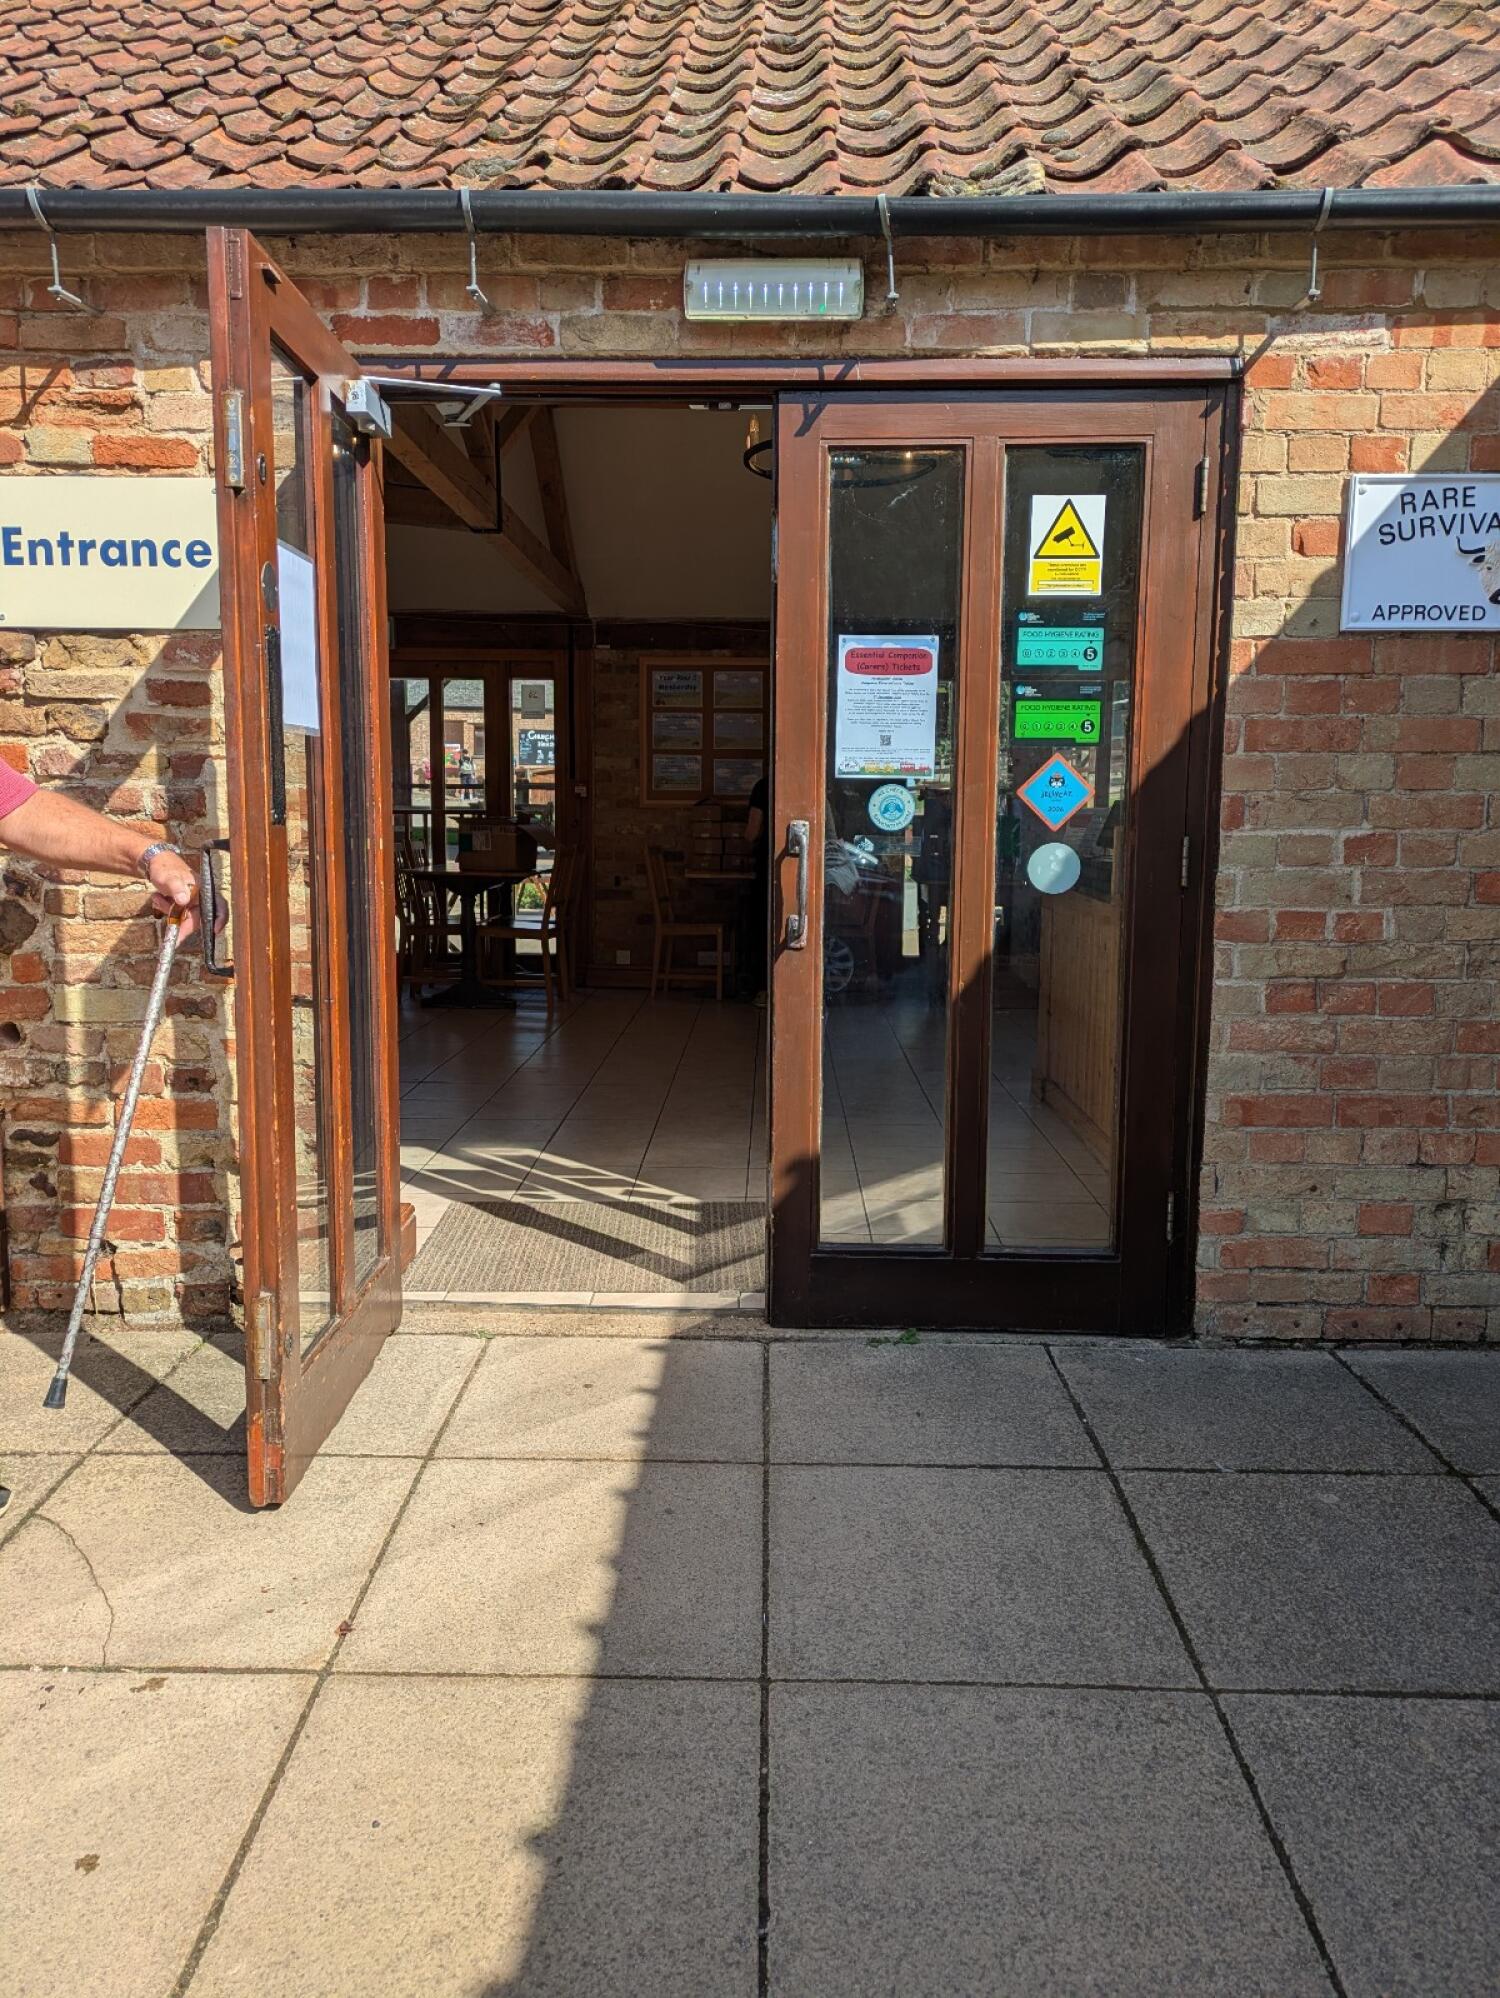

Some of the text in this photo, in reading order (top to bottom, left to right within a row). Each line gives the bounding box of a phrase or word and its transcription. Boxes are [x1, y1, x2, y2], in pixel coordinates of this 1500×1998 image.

[1399, 486, 1476, 515] RARE
[1378, 512, 1500, 546] SURVIVA
[1, 526, 212, 568] Entrance
[1371, 604, 1487, 621] APPROVED
[850, 650, 928, 660] Essential Companion
[857, 662, 921, 672] (Carers) Tickets
